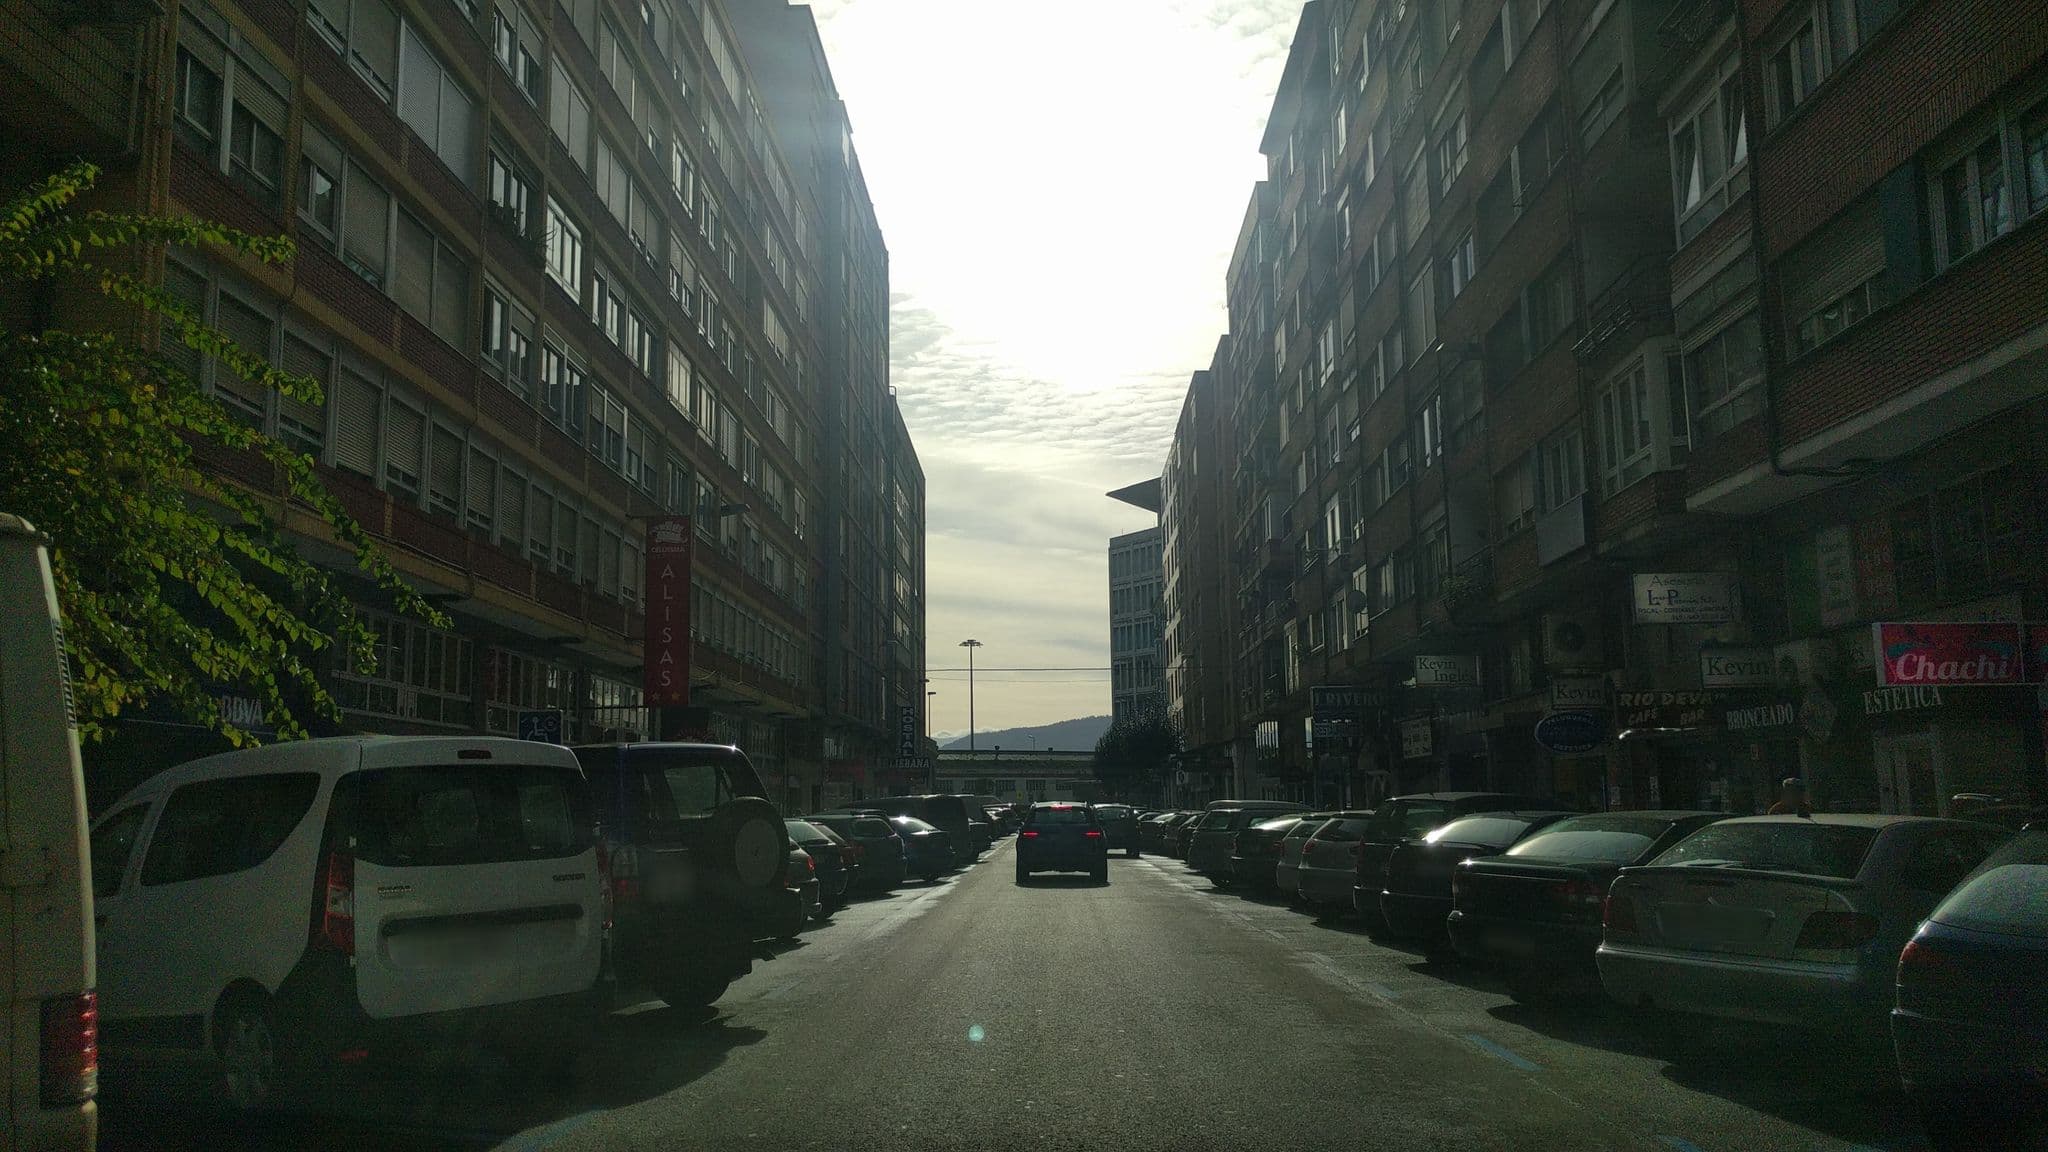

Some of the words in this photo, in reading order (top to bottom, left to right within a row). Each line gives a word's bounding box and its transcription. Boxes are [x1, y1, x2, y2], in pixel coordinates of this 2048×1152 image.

[660, 563, 676, 687] ALISAS
[1418, 657, 1457, 670] Kevin
[1707, 657, 1768, 676] Kevin
[1895, 652, 2012, 681] Chachi
[1556, 684, 1601, 699] Kevin
[222, 695, 263, 725] BBVA
[1680, 709, 1704, 725] BAR
[1726, 702, 1793, 730] BRONCEADO
[902, 708, 914, 757] HOSTAL
